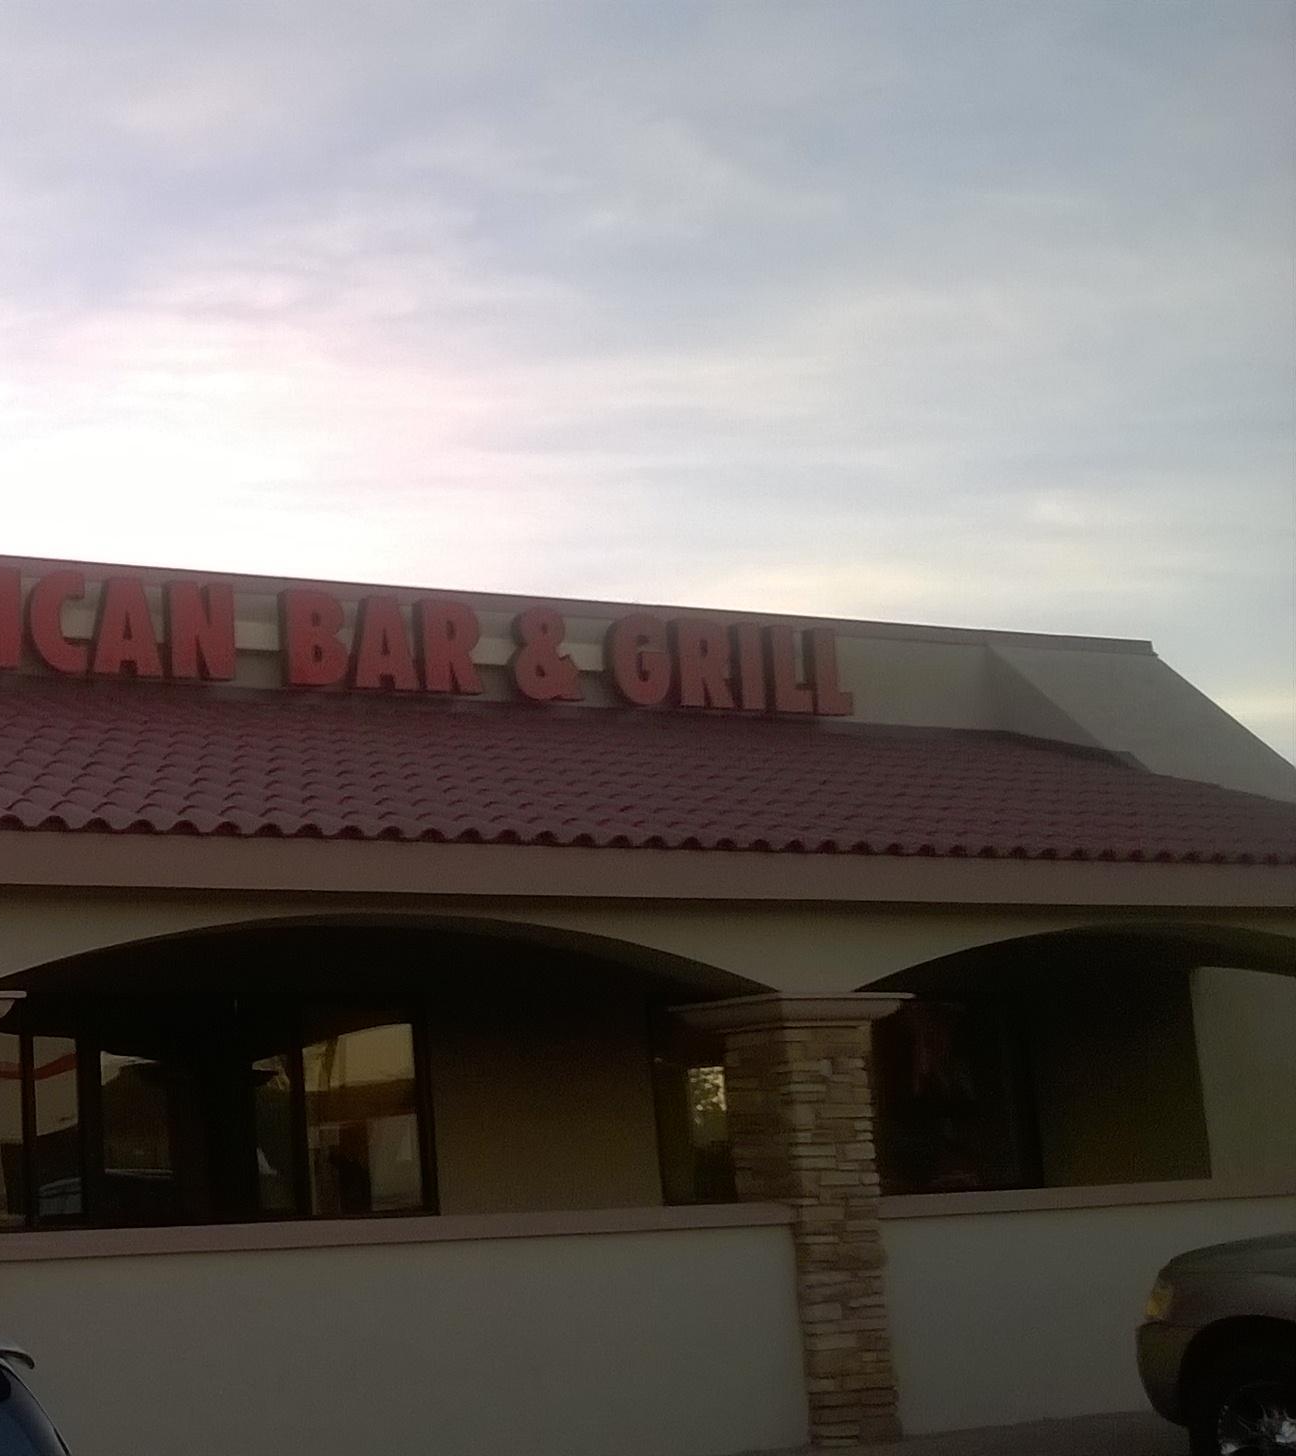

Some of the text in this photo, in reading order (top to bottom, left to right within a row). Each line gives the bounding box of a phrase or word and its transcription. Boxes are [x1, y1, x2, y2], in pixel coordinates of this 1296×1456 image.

[278, 588, 483, 696] BAR
[512, 606, 583, 702] &
[606, 612, 854, 716] GRILL
